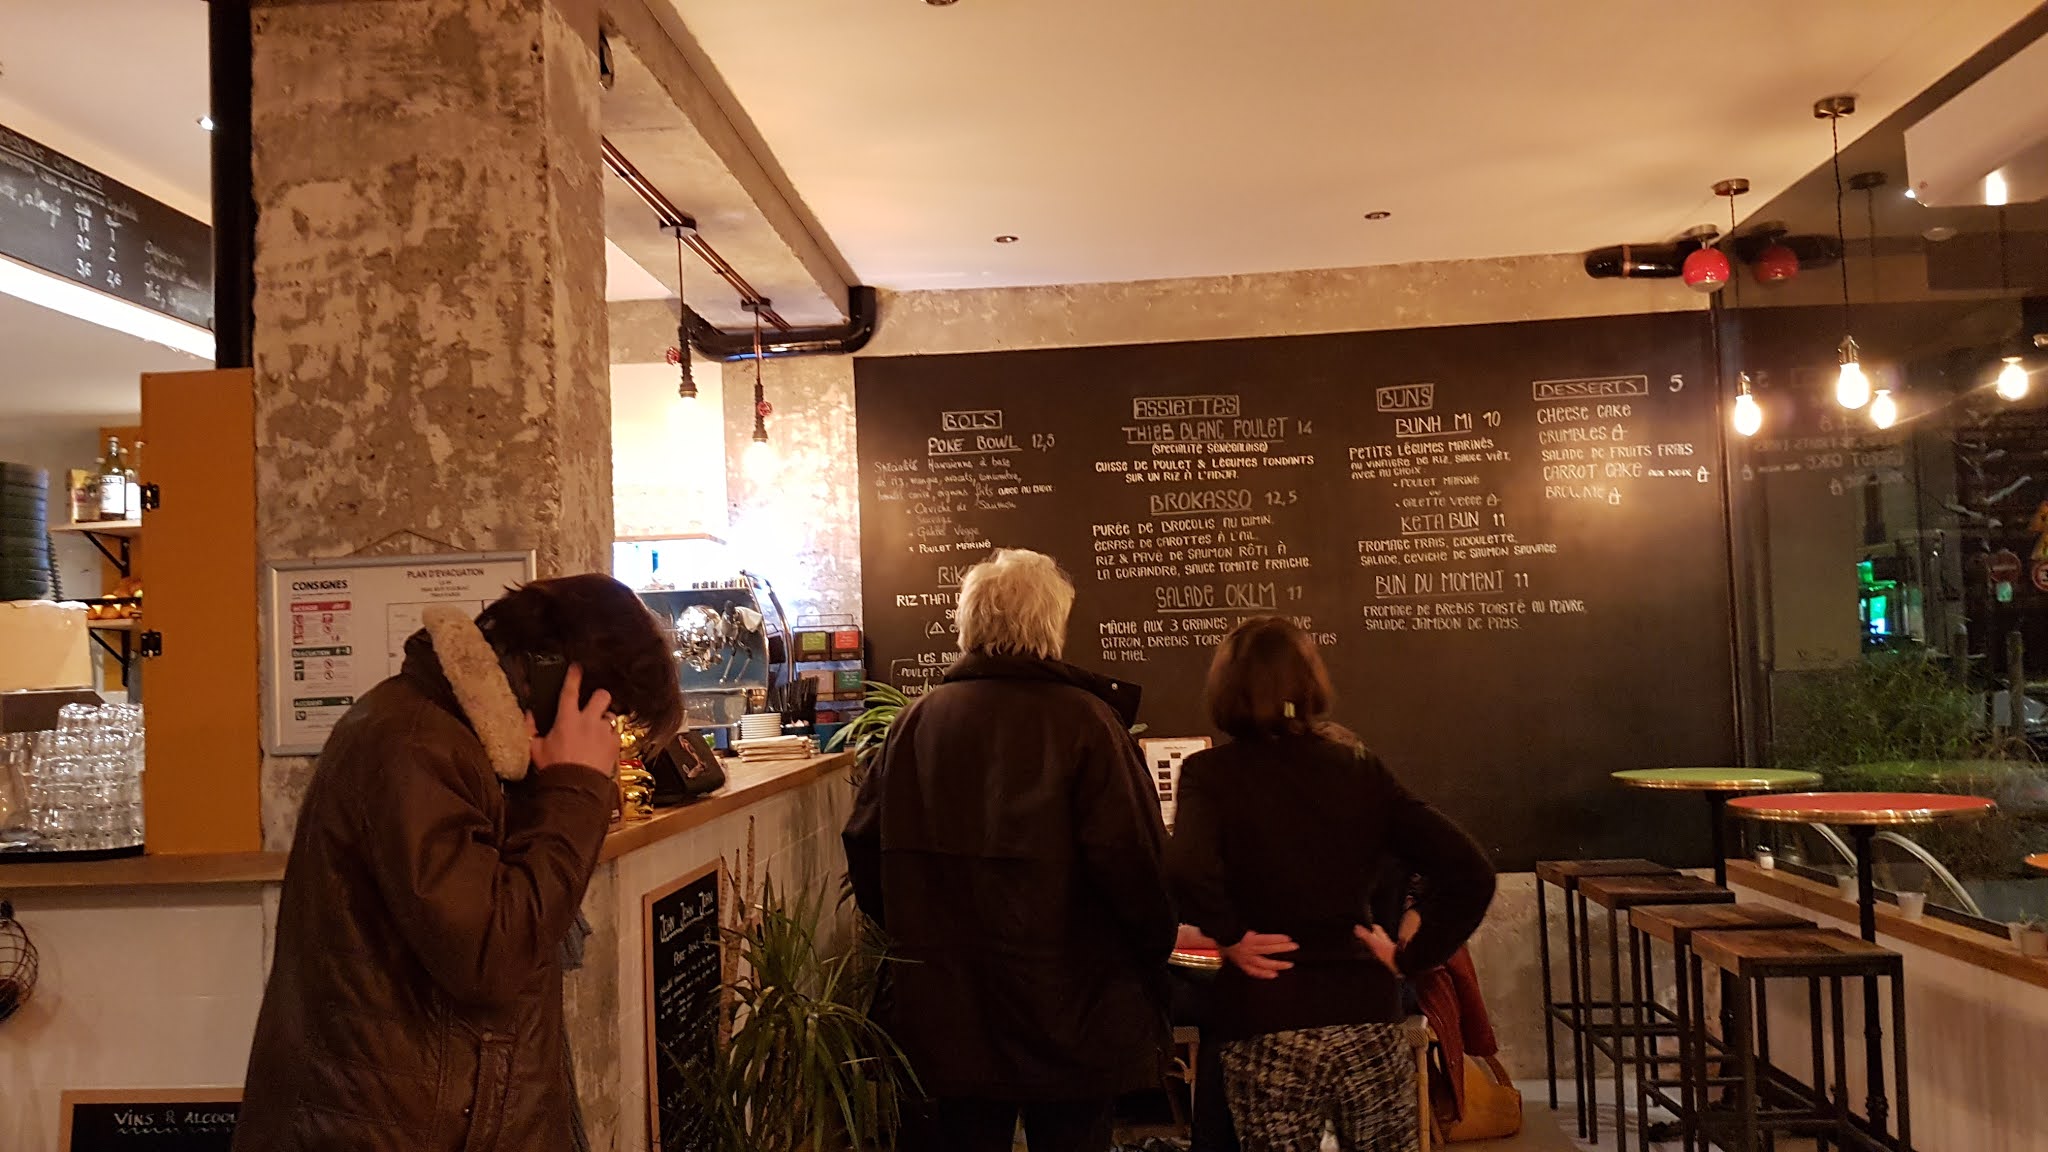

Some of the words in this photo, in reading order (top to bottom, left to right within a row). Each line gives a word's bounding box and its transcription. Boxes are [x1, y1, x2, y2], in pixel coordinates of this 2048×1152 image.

[1539, 380, 1640, 398] DESSERTS
[1669, 374, 1684, 393] 5
[1379, 387, 1432, 409] BUNS
[1136, 398, 1238, 417] ASSIETTES
[1536, 405, 1590, 425] CHEESE
[1597, 403, 1632, 418] CAKE
[945, 413, 997, 431] BOLS
[1121, 422, 1175, 442] THIEB
[1180, 418, 1225, 441] BLANC
[1233, 416, 1289, 439] POULET
[1395, 415, 1442, 436] BUNH
[1453, 412, 1473, 431] MI
[1482, 410, 1501, 428] 10
[928, 437, 965, 453] POKE
[976, 434, 1020, 450] BOWL
[1538, 426, 1607, 446] CRUMBLES
[1348, 445, 1393, 461] PETITS
[1541, 448, 1584, 462] SALADE
[1591, 447, 1605, 459] DE
[1609, 444, 1653, 459] FRUITS
[1657, 442, 1694, 457] FRAIS
[1095, 461, 1128, 473] CUISSE
[1133, 460, 1149, 471] DE
[1152, 459, 1192, 471] POULET
[1262, 454, 1315, 467] FONDANTS
[1350, 462, 1364, 471] AU
[1415, 456, 1430, 466] DE
[1454, 453, 1482, 464] SAUCE
[1125, 472, 1146, 484] SUR
[1147, 471, 1161, 483] UN
[1163, 470, 1181, 482] RIZ
[1351, 469, 1377, 480] AVEC
[1378, 468, 1392, 478] AU
[1543, 463, 1598, 482] CARROT
[1605, 461, 1643, 478] CAKE
[1400, 477, 1437, 488] POULET
[1150, 488, 1253, 514] BROKASSO
[1092, 521, 1131, 538] PURÉE
[1137, 522, 1154, 536] DE
[1161, 515, 1216, 534] BROCOLIS
[1222, 517, 1238, 530] AU
[1401, 513, 1446, 533] KETA
[1447, 511, 1481, 530] BUN
[1492, 512, 1506, 528] 11
[919, 543, 952, 554] POULET
[1139, 538, 1154, 550] DE
[1156, 533, 1212, 549] CAROTTES
[1357, 538, 1411, 553] FROMAGE
[1096, 554, 1116, 567] RIZ
[1119, 553, 1130, 565] &
[1169, 550, 1185, 562] DE
[1187, 546, 1233, 561] SAUMON
[1277, 540, 1288, 555] À
[1403, 550, 1449, 564] CEVICHE
[1451, 549, 1467, 561] DE
[1469, 546, 1511, 559] SAUMON
[1513, 542, 1558, 556] SAUVAGE
[407, 570, 428, 579] PLAN
[1097, 568, 1112, 581] LA
[1184, 563, 1216, 576] SAUCE
[1218, 559, 1260, 574] TOMATE
[292, 580, 348, 591] CONSIGNES
[1375, 572, 1408, 596] BUN
[1414, 571, 1434, 594] DU
[1440, 569, 1505, 592] MOMENT
[1513, 572, 1530, 589] 11
[896, 594, 919, 608] RIZ
[920, 592, 951, 606] THAI
[1155, 584, 1215, 609] SALADE
[1225, 581, 1277, 609] OKLM
[1363, 603, 1414, 618] FROMAGE
[1416, 603, 1431, 616] DE
[1435, 601, 1477, 615] BREBIS
[1531, 600, 1546, 614] AU
[1143, 619, 1164, 634] AUX
[1169, 618, 1180, 632] 3
[1411, 616, 1463, 631] JAMBON
[1467, 615, 1484, 631] DE
[1147, 633, 1190, 648] BREBIS
[917, 651, 936, 664] LES
[1102, 650, 1118, 662] AU
[902, 685, 923, 696] TOUS
[114, 1109, 154, 1126] VINS
